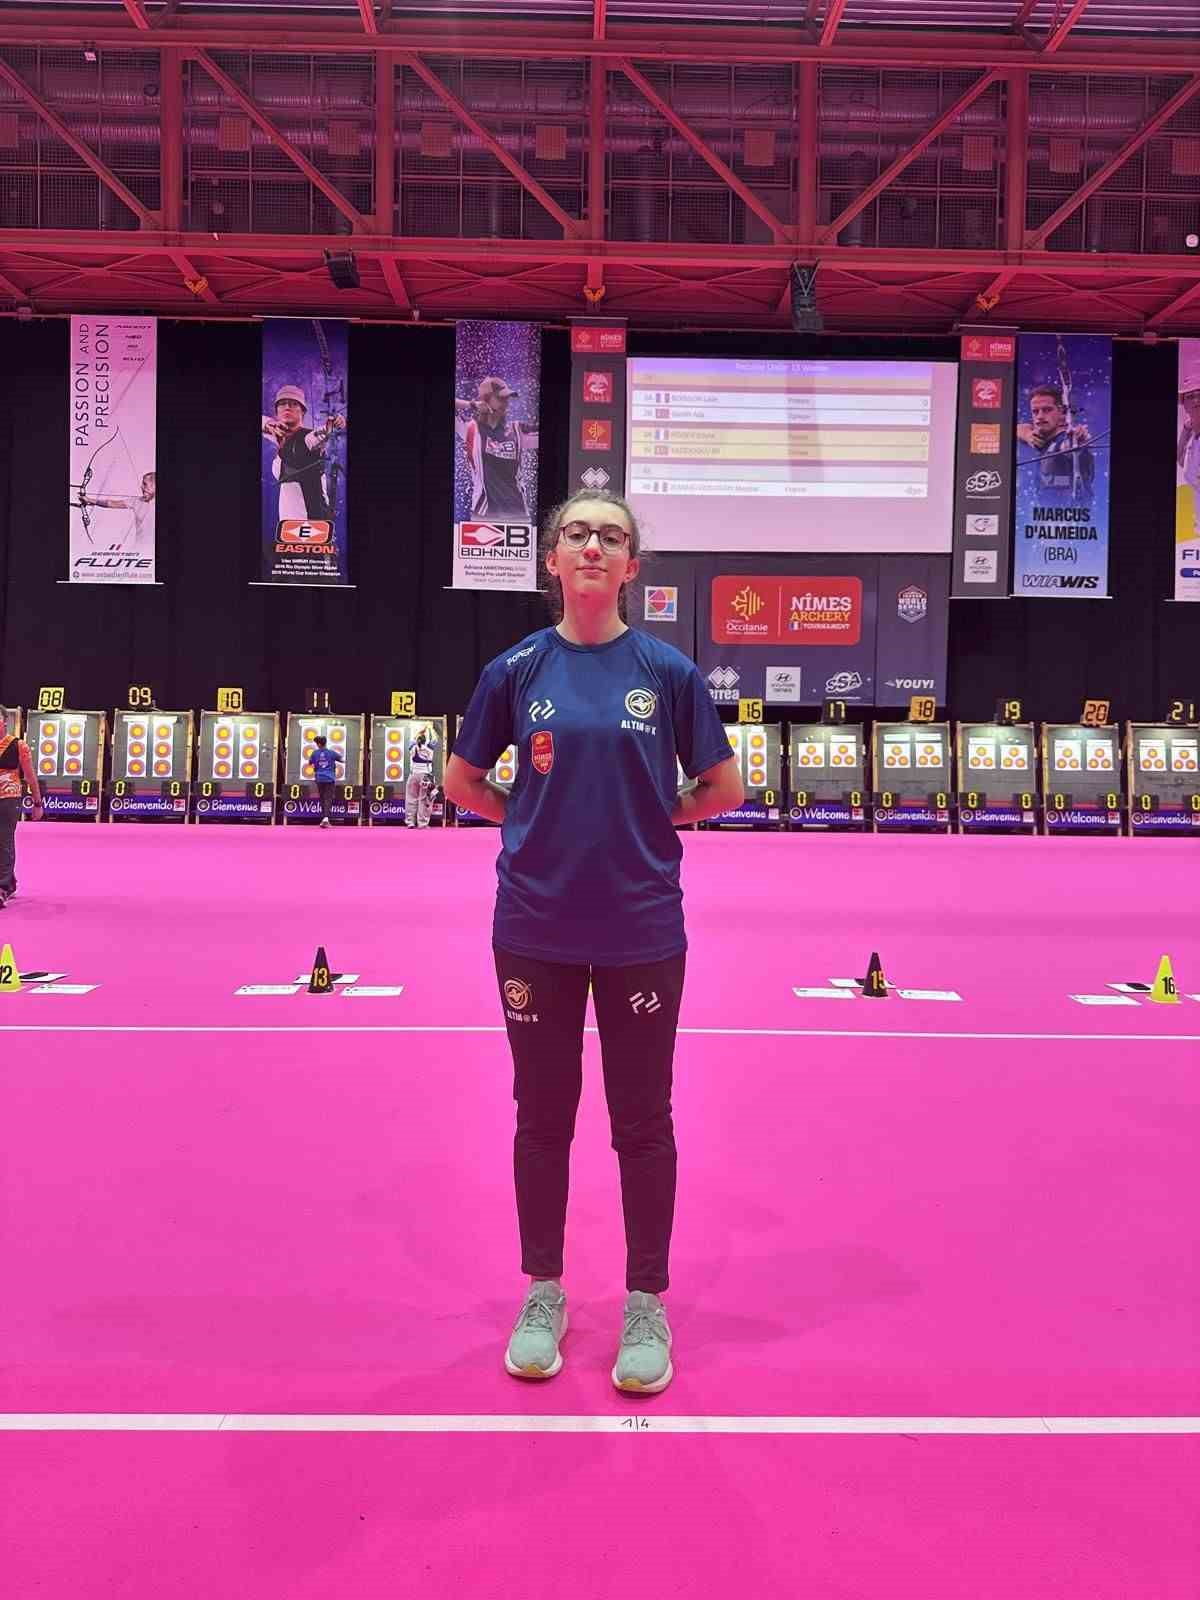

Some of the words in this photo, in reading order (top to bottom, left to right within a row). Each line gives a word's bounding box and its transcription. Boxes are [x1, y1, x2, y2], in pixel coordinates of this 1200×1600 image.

[79, 323, 89, 354] AND
[95, 324, 109, 428] PRECISION
[75, 363, 89, 446] PASSION
[1033, 506, 1091, 522] MARCUS
[299, 526, 312, 538] E
[506, 525, 530, 547] B
[1025, 525, 1098, 540] D'ALMEIDA
[275, 543, 335, 554] EASTON
[460, 547, 530, 558] BOHNING
[1043, 546, 1078, 564] (BRA)
[74, 557, 153, 568] FLUTE
[1022, 574, 1099, 588] WIAWIS
[790, 592, 852, 611] NÎMES
[790, 611, 851, 622] ARCHERY
[726, 622, 768, 632] Occitanie
[895, 679, 935, 689] YOUYI
[40, 690, 62, 707] 08
[128, 687, 151, 705] 09
[225, 691, 241, 709] 10
[313, 692, 328, 708] 11
[400, 695, 413, 712] 12
[747, 702, 761, 719] 16
[830, 701, 845, 718] 17
[919, 700, 934, 718] 18
[1004, 701, 1020, 719] 19
[1085, 704, 1107, 721] 20
[1172, 701, 1195, 720] 21
[81, 780, 90, 795] 0
[115, 781, 125, 796] 0
[170, 781, 180, 797] 0
[202, 782, 212, 797] 0
[255, 782, 265, 797] 0
[290, 784, 300, 799] 0
[344, 785, 353, 800] 0
[375, 785, 385, 801] 0
[123, 799, 173, 810] Bienvenido
[211, 800, 258, 812] Bienvenue
[765, 790, 775, 806] 0
[797, 791, 807, 807] 0
[851, 791, 861, 807] 0
[882, 791, 892, 807] 0
[936, 792, 946, 808] 0
[968, 792, 977, 808] 0
[1022, 793, 1032, 809] 0
[1055, 793, 1064, 809] 0
[1107, 793, 1117, 809] 0
[1141, 794, 1151, 811] 0
[300, 801, 345, 813] Welme
[804, 808, 850, 820] Welcome
[887, 809, 936, 821] Bienvenido
[975, 810, 1020, 822] Bienvenue
[1061, 812, 1106, 824] Welcome
[1143, 812, 1192, 825] Bienvenido
[313, 967, 328, 987] 13
[871, 970, 889, 989] 15
[1162, 976, 1175, 994] 16
